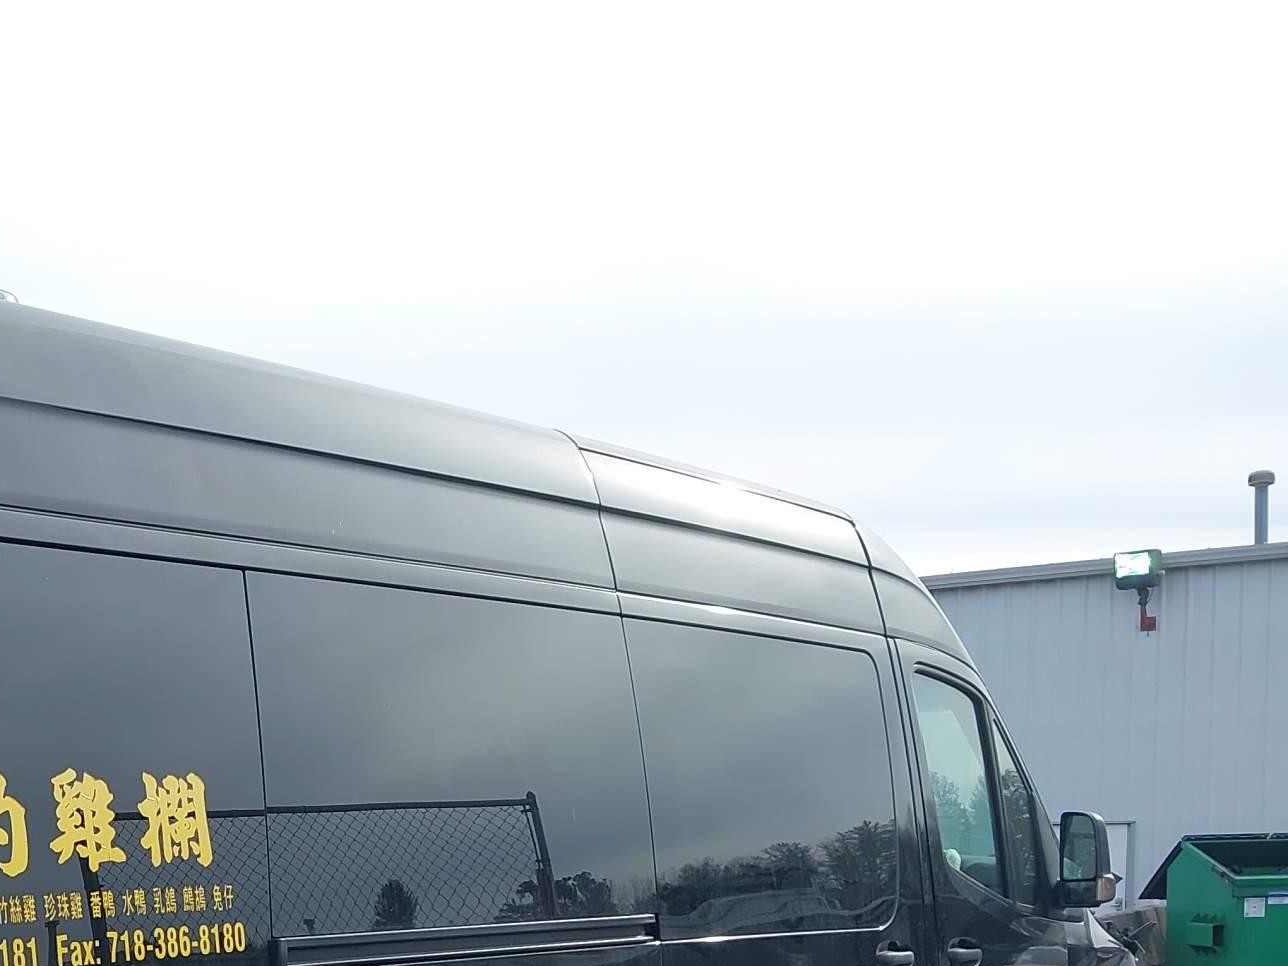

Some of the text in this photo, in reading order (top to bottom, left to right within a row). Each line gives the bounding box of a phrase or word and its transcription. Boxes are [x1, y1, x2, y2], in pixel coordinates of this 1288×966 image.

[44, 892, 84, 921] 珍珠雞
[122, 888, 147, 916] 水鴨
[106, 921, 246, 963] 718-386-8180
